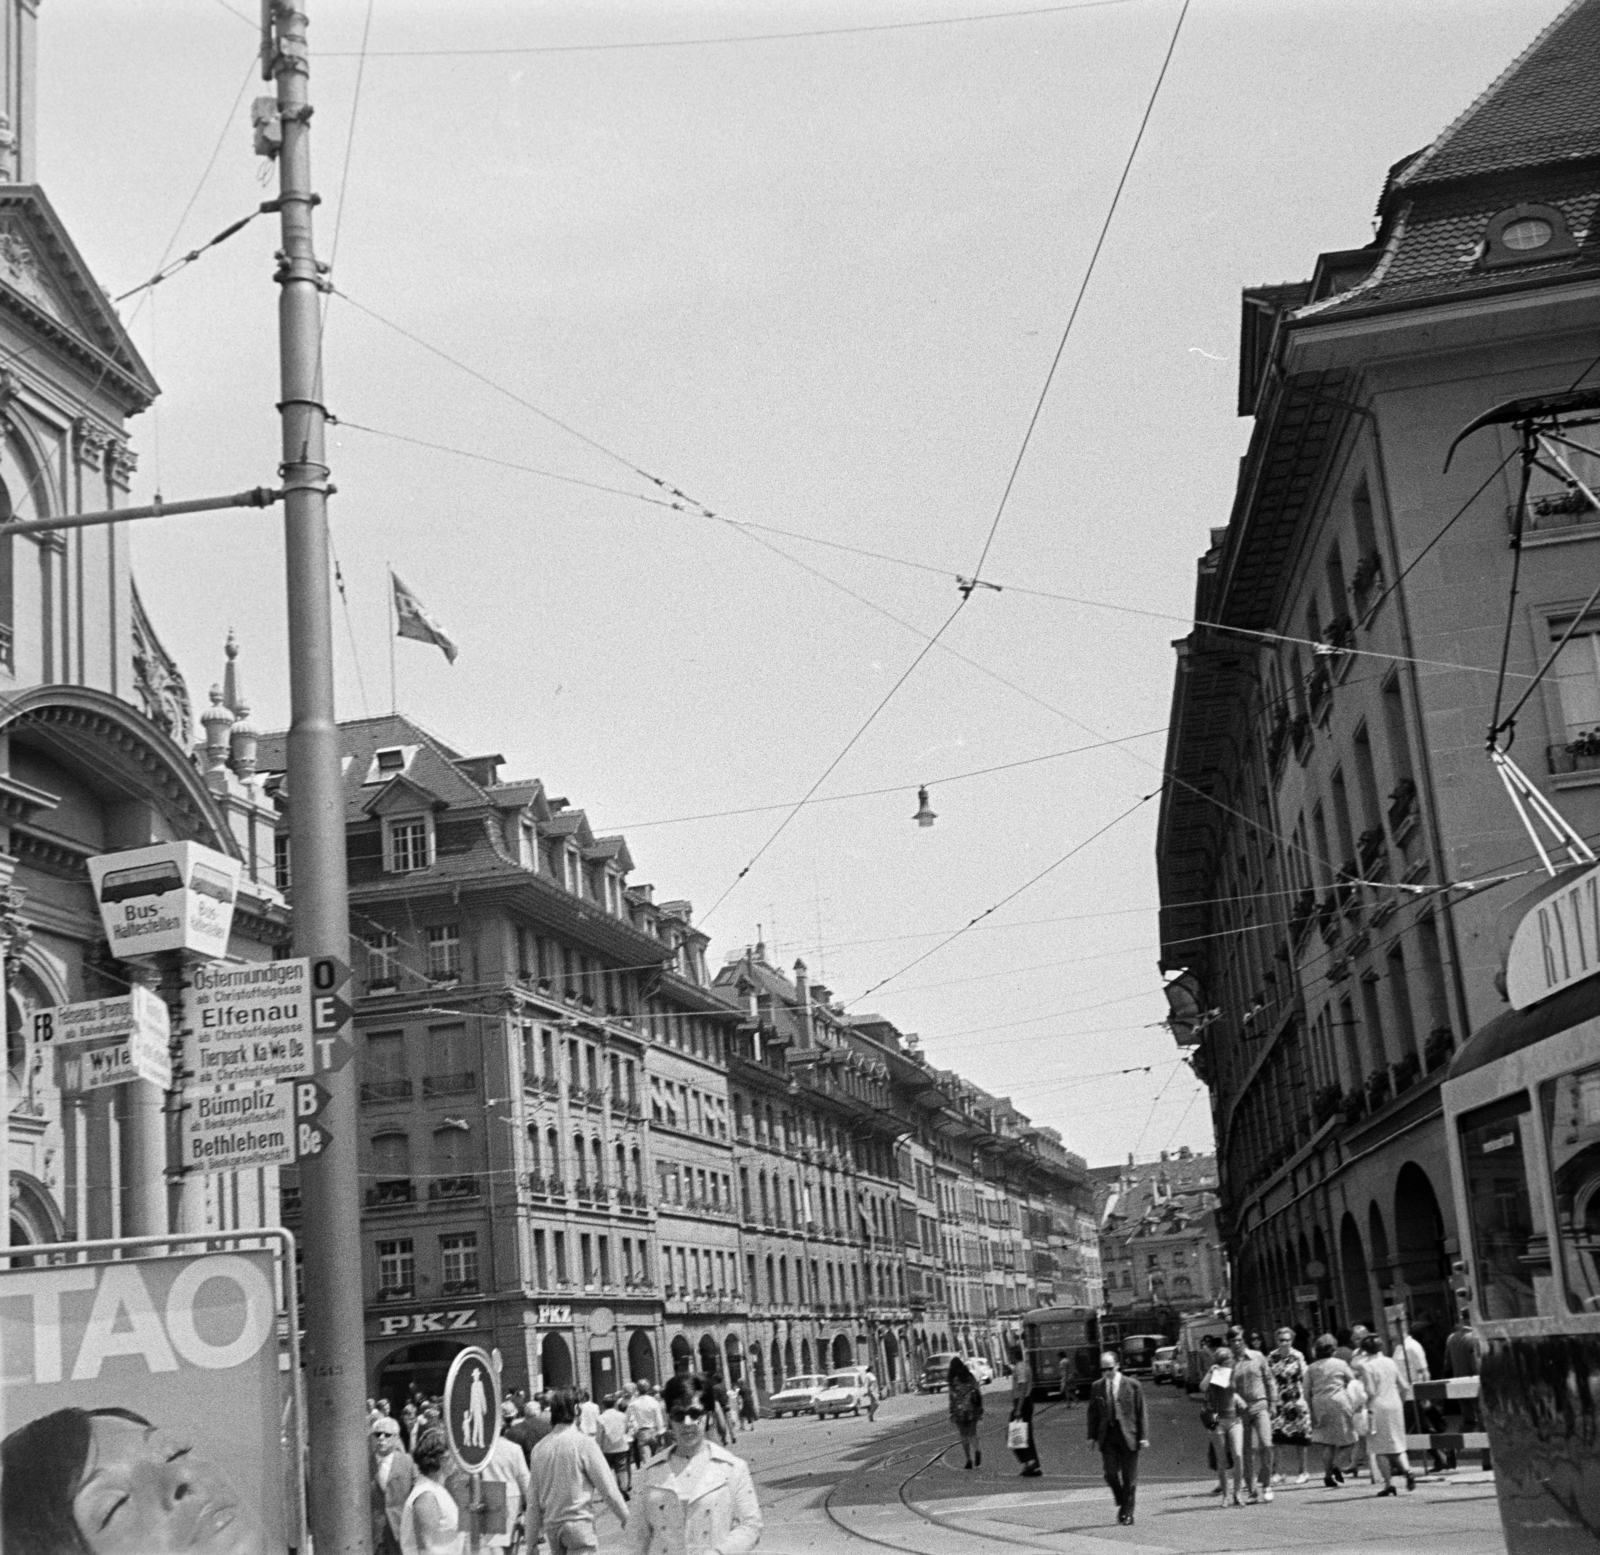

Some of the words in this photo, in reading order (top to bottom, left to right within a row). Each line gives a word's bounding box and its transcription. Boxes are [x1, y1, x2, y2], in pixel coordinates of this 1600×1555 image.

[125, 904, 164, 921] Bus-
[194, 962, 304, 990] Ostermundigen
[313, 960, 335, 990] O
[201, 1003, 298, 1028] Elfenau
[315, 996, 336, 1029] E
[34, 1013, 53, 1043] FB
[200, 1043, 247, 1068] Tierpark
[316, 1037, 336, 1070] T
[199, 1089, 275, 1118] Bümpliz
[297, 1083, 318, 1117] B
[193, 1131, 284, 1158] Bethlehem
[299, 1123, 323, 1156] Be
[379, 1309, 477, 1336] PKZ
[538, 1305, 571, 1323] PKZ
